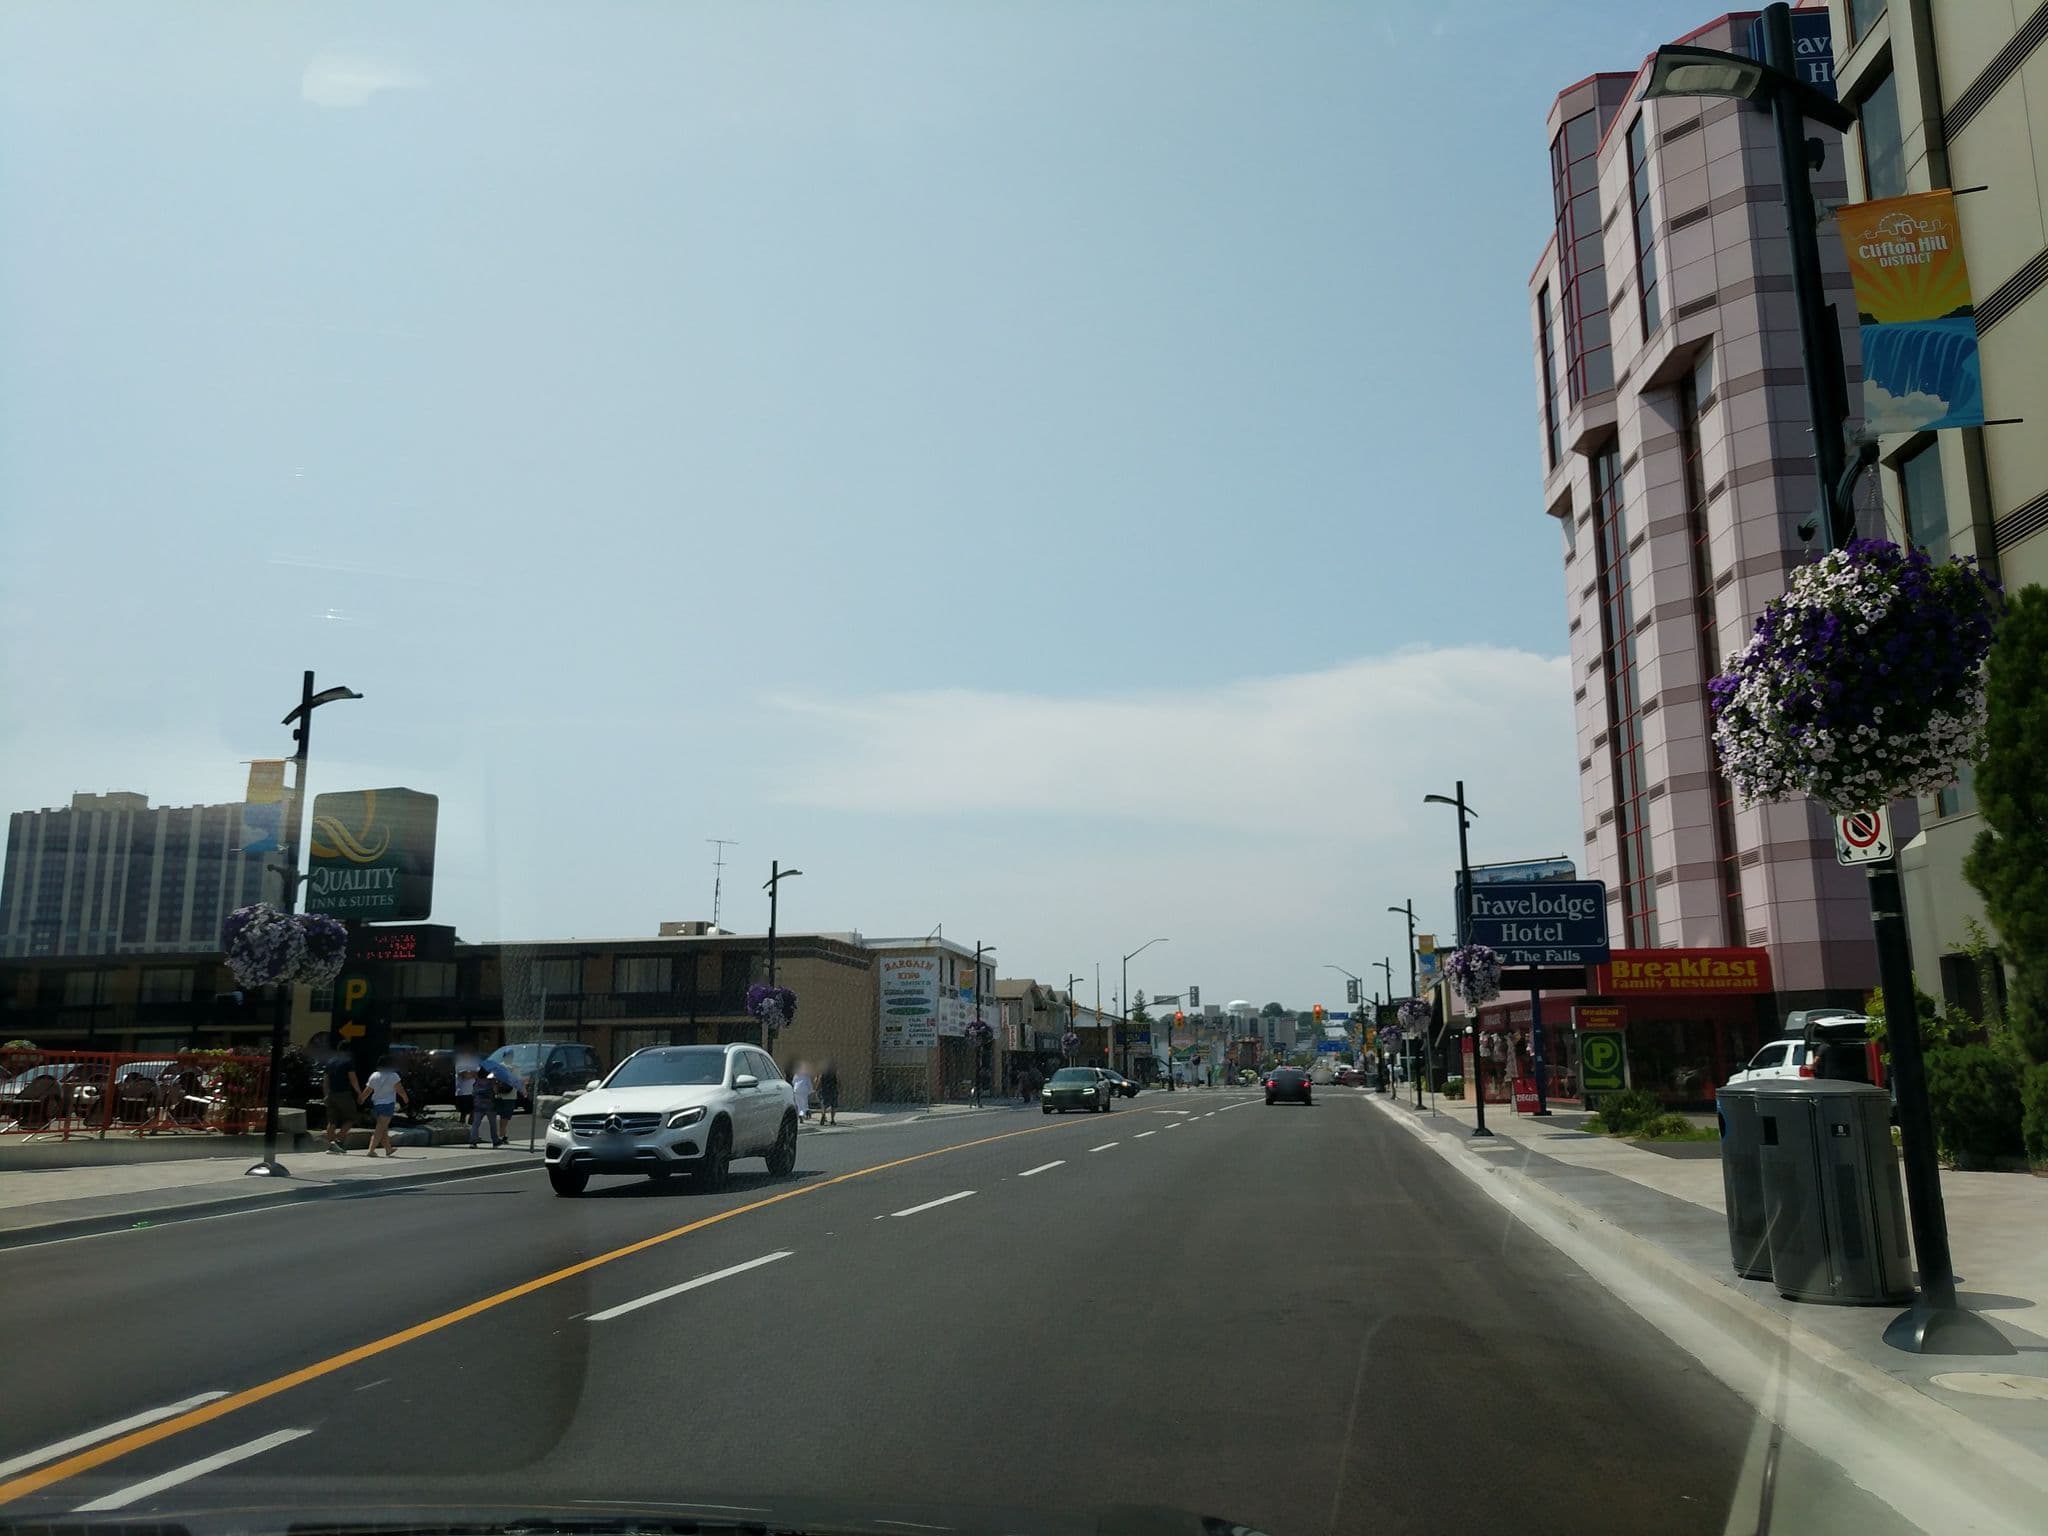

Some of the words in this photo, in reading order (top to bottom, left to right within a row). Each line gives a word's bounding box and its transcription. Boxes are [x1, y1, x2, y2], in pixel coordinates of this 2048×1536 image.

[1859, 241, 1917, 259] Clifton
[1919, 235, 1949, 252] Hill
[1880, 252, 1931, 268] DISTRICT
[312, 867, 398, 895] QUALITY
[312, 898, 336, 910] INN
[338, 897, 347, 907] &
[350, 895, 395, 907] SUITES
[1471, 892, 1595, 920] Travelodge
[1501, 922, 1564, 942] Hotel
[1512, 949, 1541, 962] The
[1545, 949, 1581, 962] Falls
[1611, 957, 1758, 977] Breakfast
[1611, 978, 1665, 990] Family
[1670, 976, 1758, 989] Restaurant
[345, 979, 367, 1011] P
[1592, 1042, 1613, 1068] P
